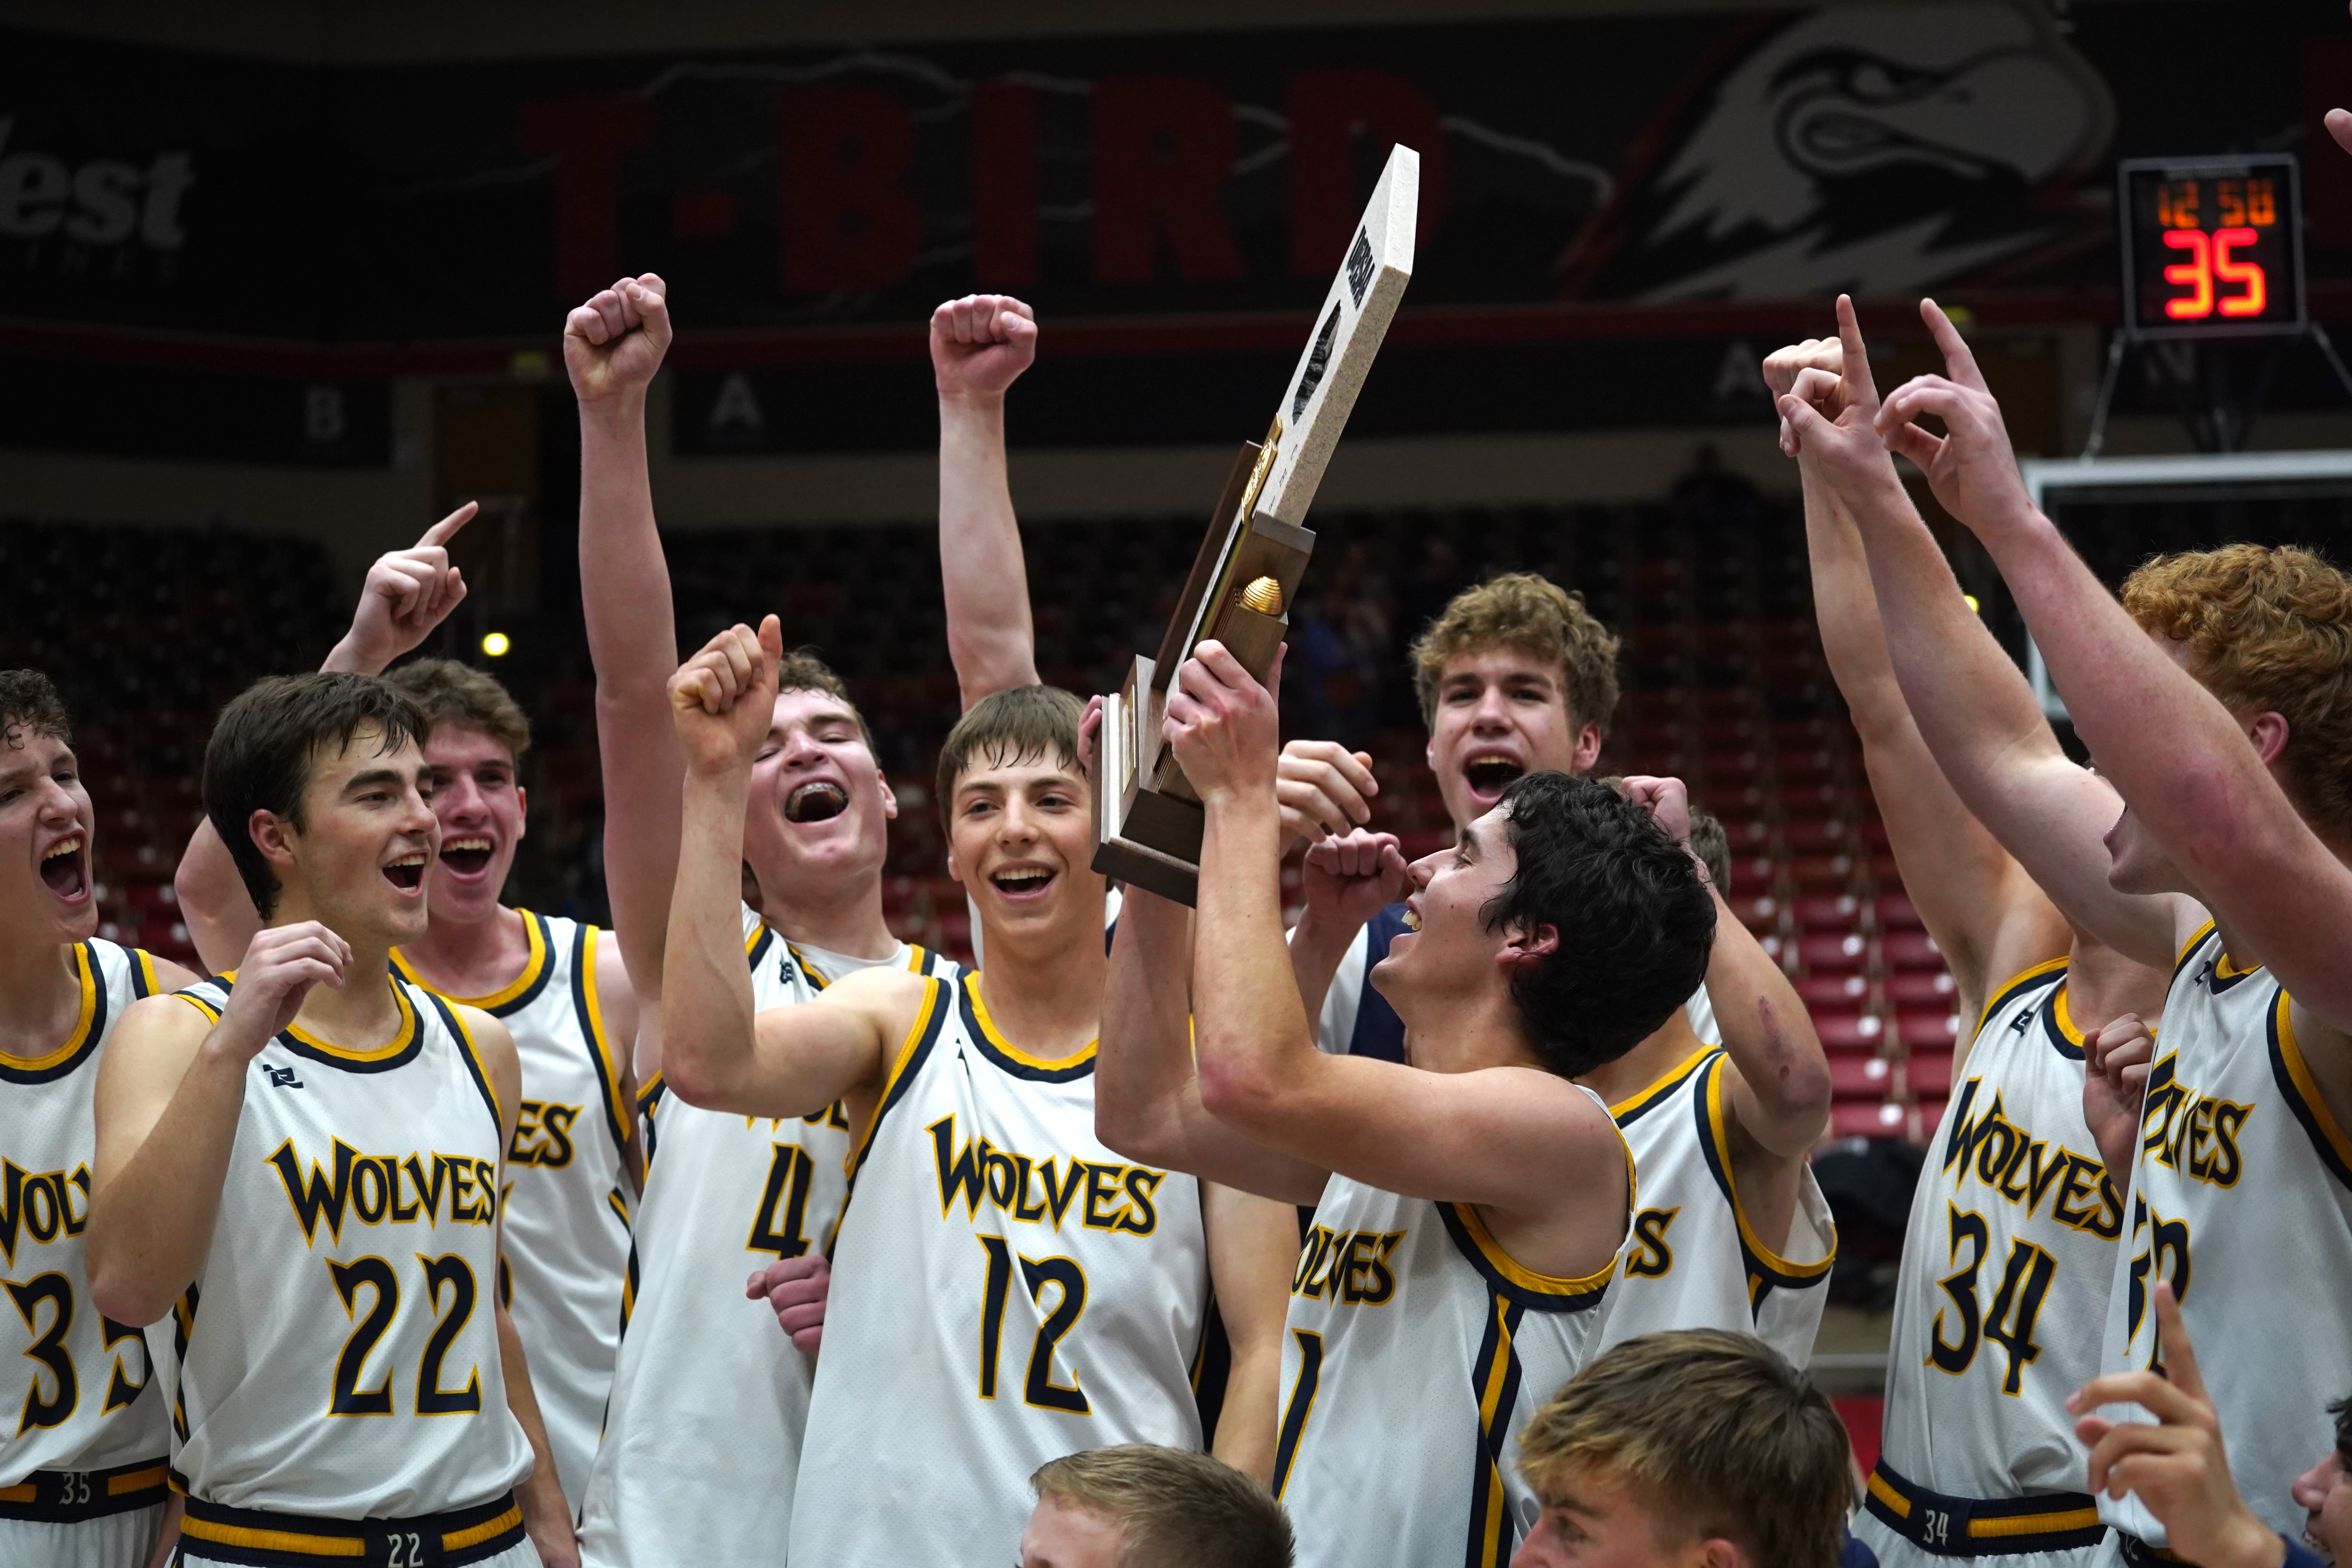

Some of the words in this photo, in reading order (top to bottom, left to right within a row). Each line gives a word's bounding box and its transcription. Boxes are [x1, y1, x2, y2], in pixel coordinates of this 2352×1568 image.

[0, 112, 197, 251] est
[516, 65, 1451, 303] T-BIRD
[2162, 227, 2267, 319] 35
[306, 384, 346, 443] B
[709, 371, 764, 429] A
[265, 1135, 498, 1249] WOLVES
[745, 1141, 815, 1261] 4
[924, 1112, 1167, 1237] WOLVES
[1942, 1075, 2125, 1241] WOLVES
[1291, 1221, 1408, 1309] OLVES
[1926, 1200, 2057, 1398] 34
[325, 1252, 481, 1416] 22
[976, 1233, 1092, 1415] 12
[59, 1472, 90, 1505] 35
[1923, 1508, 1949, 1546] 34
[386, 1533, 424, 1568] 22
